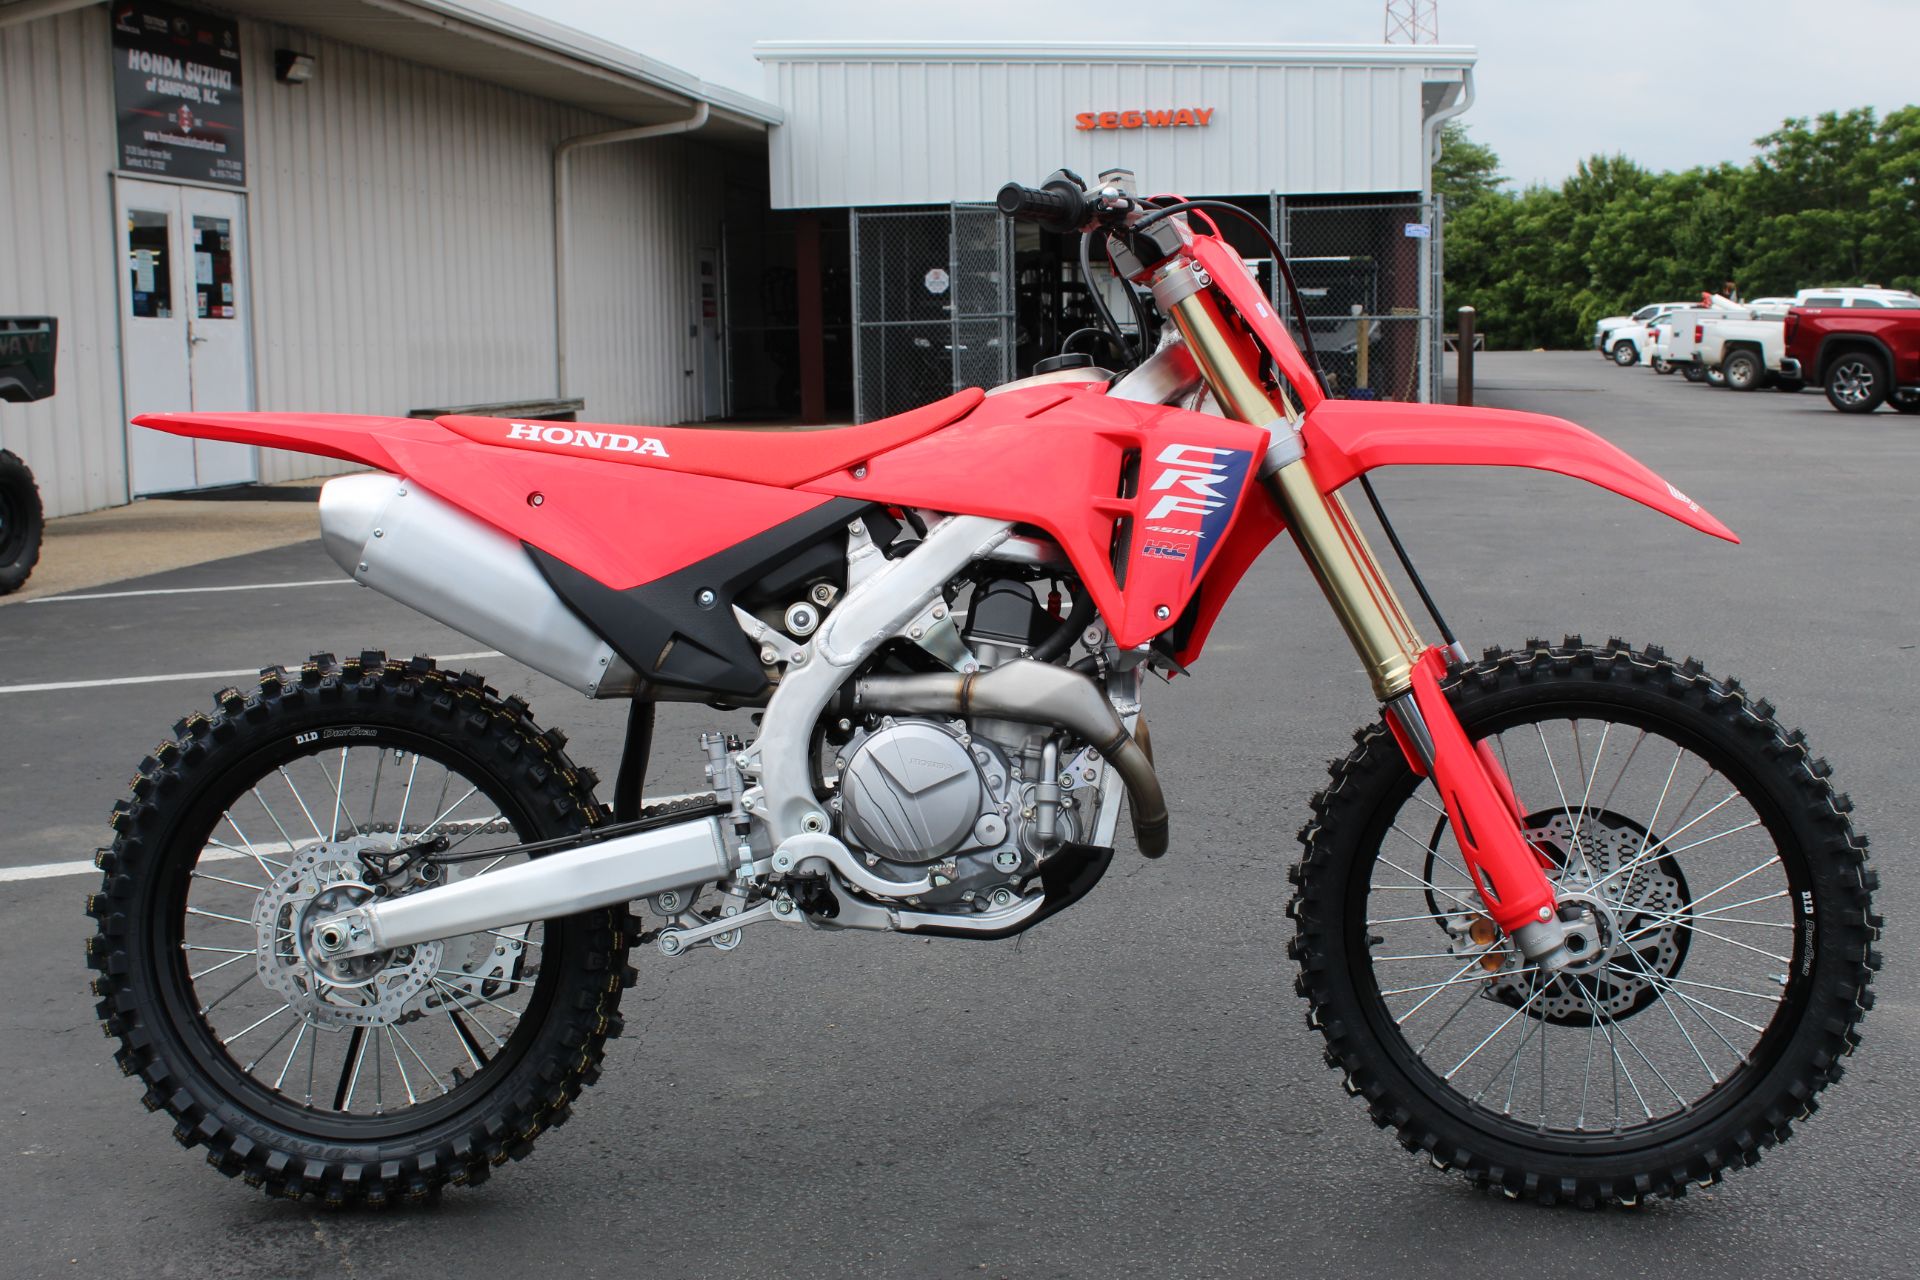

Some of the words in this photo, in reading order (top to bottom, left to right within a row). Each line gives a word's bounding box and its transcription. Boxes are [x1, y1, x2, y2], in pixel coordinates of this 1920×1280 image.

[128, 48, 183, 80] HONDA
[185, 61, 232, 91] SUZUKI
[1075, 107, 1215, 131] SEGWAY
[506, 423, 669, 458] HONDA
[1144, 443, 1235, 520] CRF
[1144, 525, 1207, 539] 450R
[1143, 538, 1191, 558] HRC
